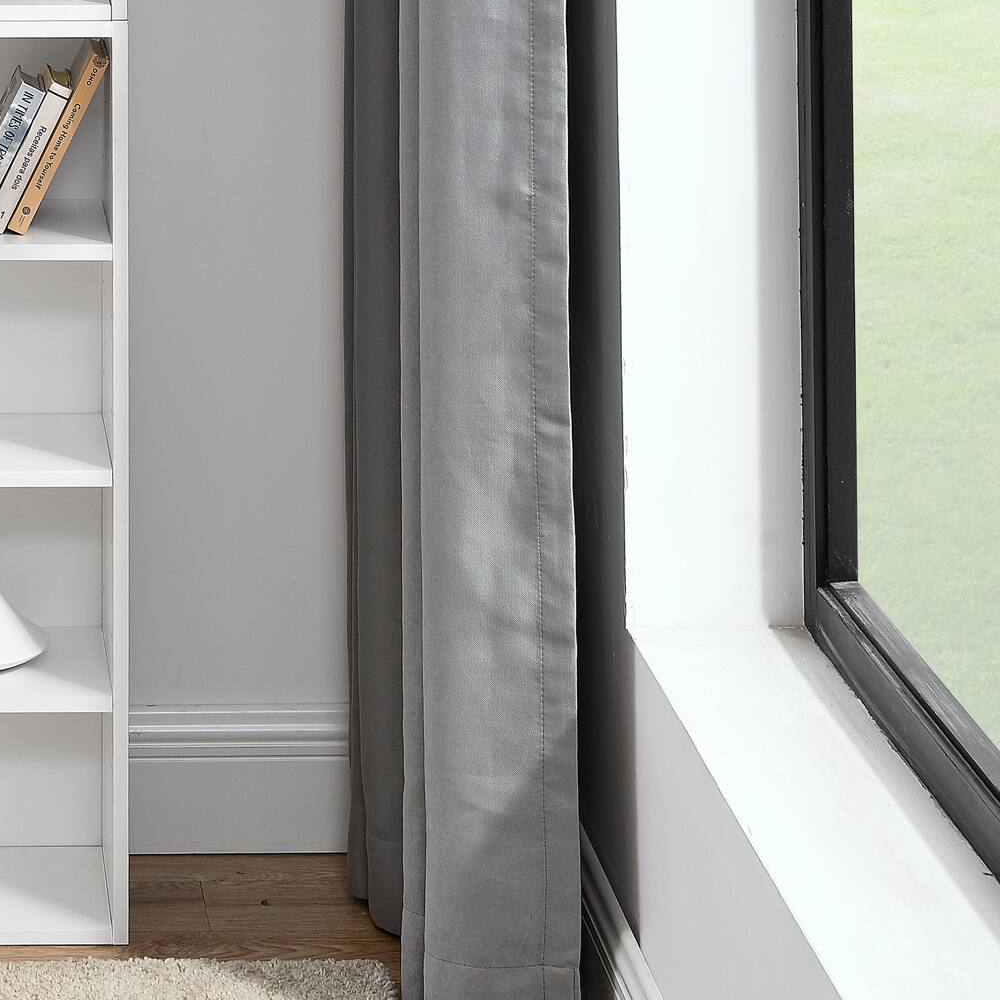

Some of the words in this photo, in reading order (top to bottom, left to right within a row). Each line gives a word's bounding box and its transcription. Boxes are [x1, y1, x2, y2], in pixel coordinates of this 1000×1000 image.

[86, 68, 98, 85] OSHO
[21, 91, 34, 104] IN
[8, 104, 29, 131] TIMES
[63, 103, 81, 130] Coming
[2, 130, 15, 145] OF
[27, 125, 48, 157] Receitas
[53, 130, 68, 152] Home
[48, 151, 57, 160] to
[18, 156, 31, 175] para
[11, 174, 23, 191] dois
[34, 161, 53, 191] Yourself
